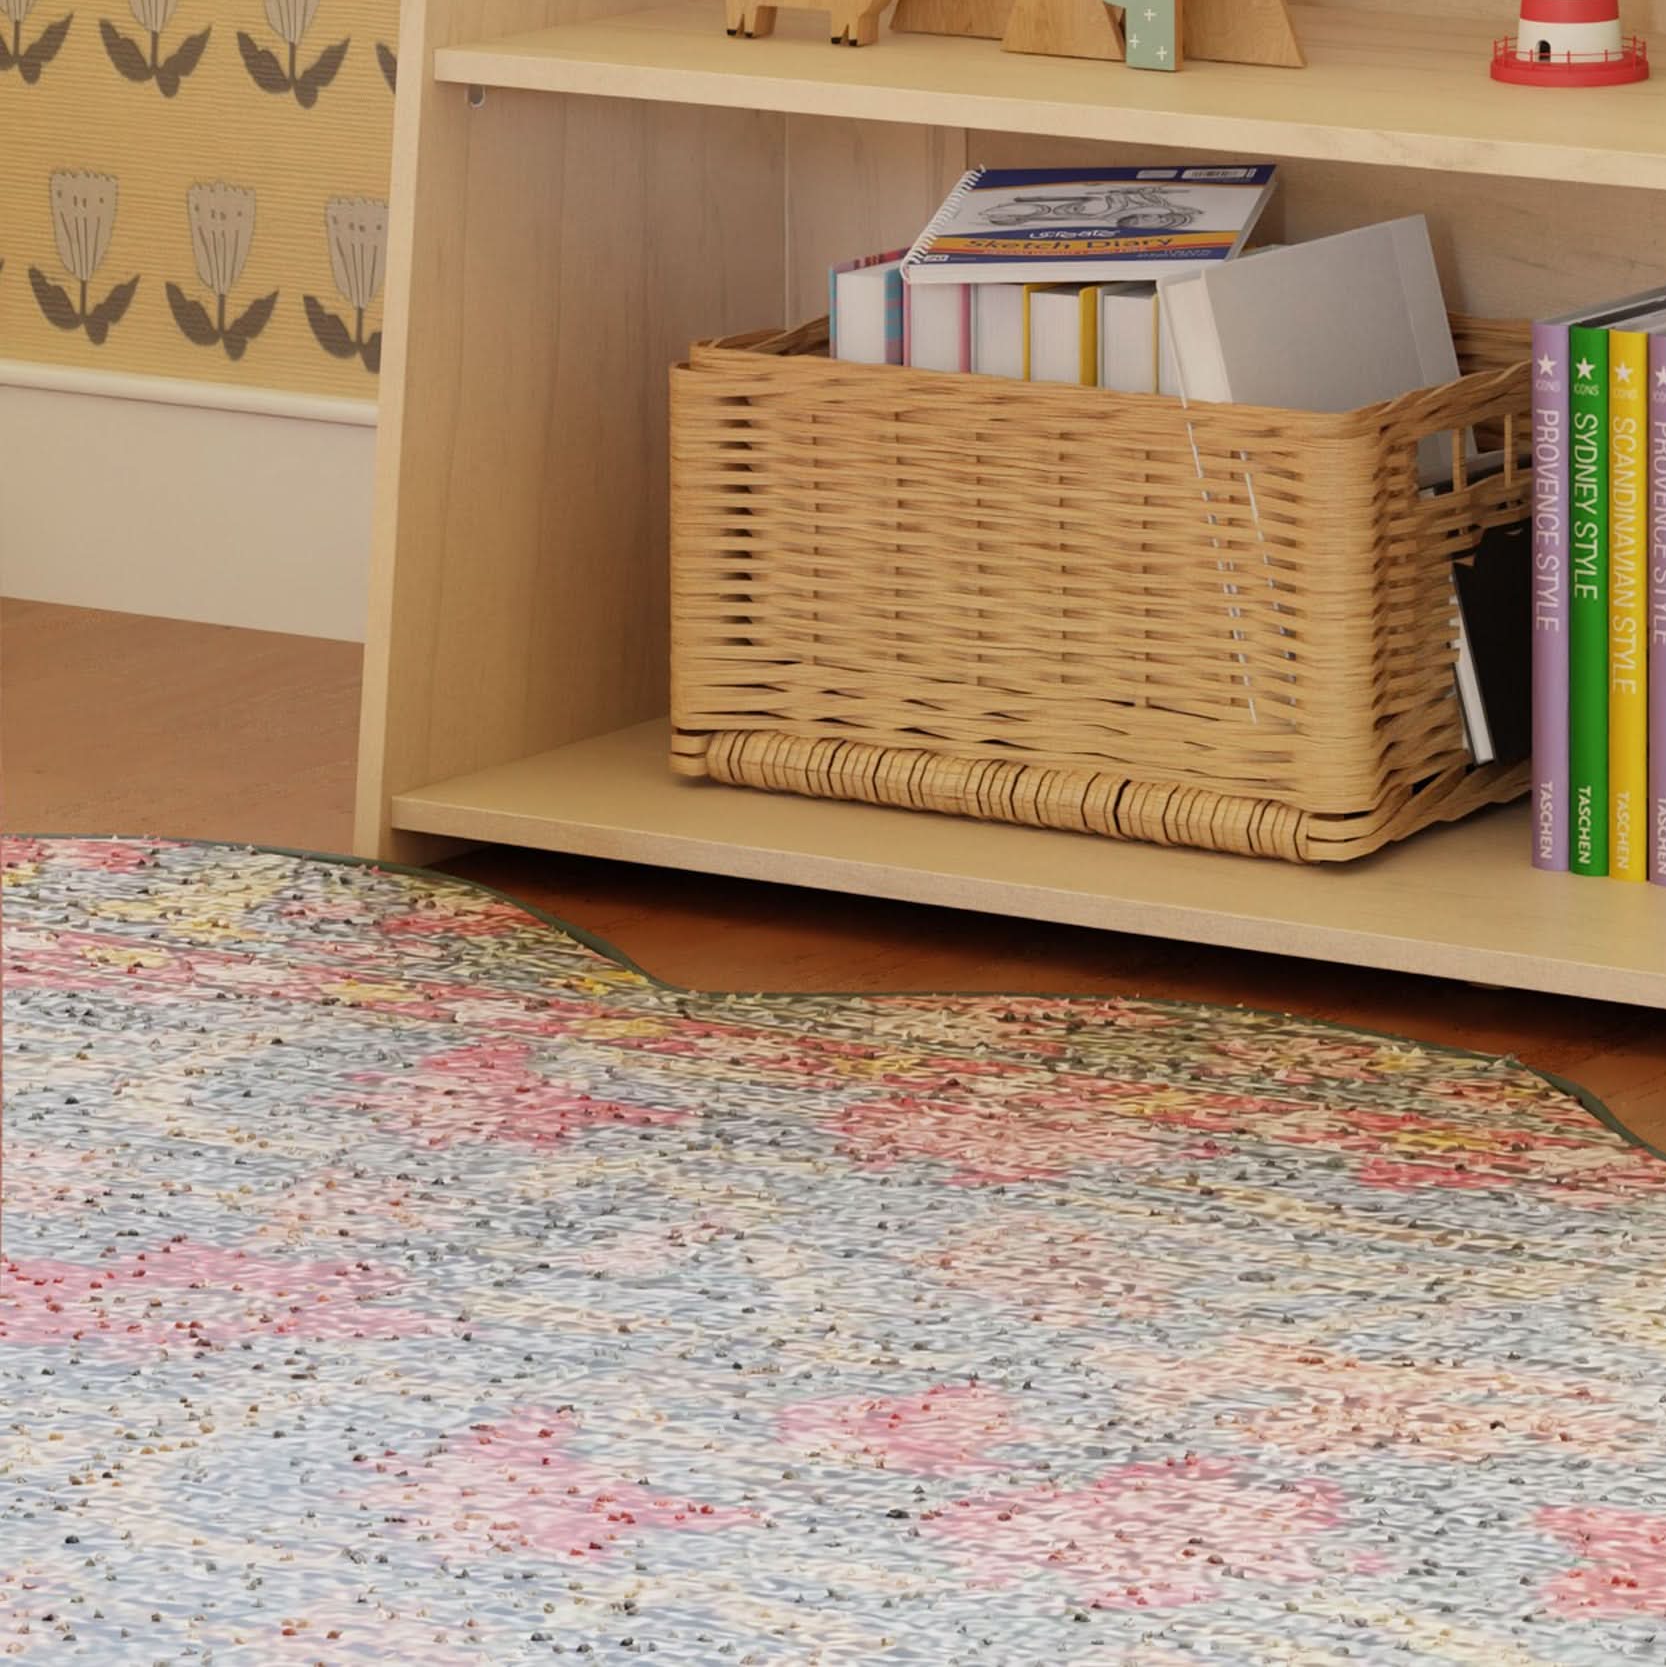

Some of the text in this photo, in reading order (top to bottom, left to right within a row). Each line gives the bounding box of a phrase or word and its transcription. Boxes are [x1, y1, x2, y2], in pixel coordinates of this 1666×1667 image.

[1535, 408, 1560, 632] PROVENCE STYLE
[1573, 412, 1599, 601] SYDNEY STYLE
[1612, 416, 1637, 696] SCANDINAVIAN STYLE
[1539, 781, 1554, 860] TASCHEN
[1577, 785, 1592, 865] TASCHEN
[1616, 791, 1631, 871] TASCHEN
